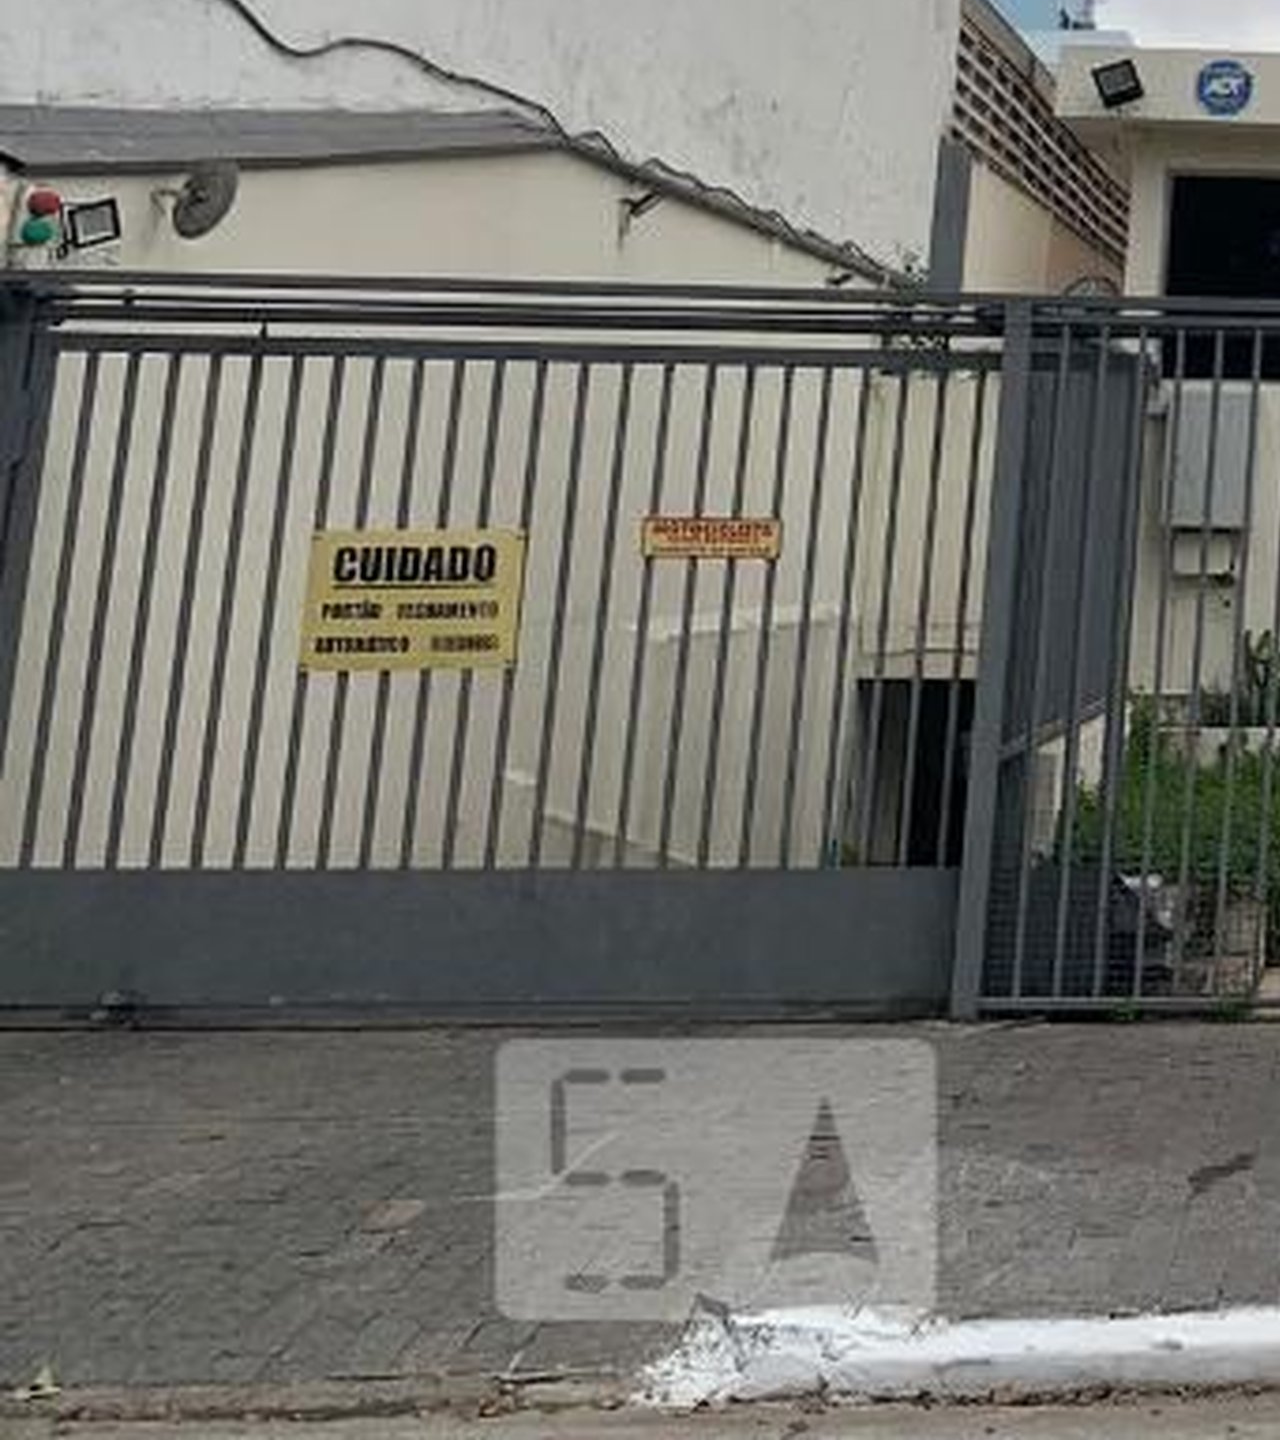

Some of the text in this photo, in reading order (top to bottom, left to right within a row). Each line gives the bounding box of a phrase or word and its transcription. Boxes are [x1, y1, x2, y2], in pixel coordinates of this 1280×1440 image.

[333, 543, 498, 582] CUIDADO
[321, 599, 500, 620] PORTÃO FECHAMENTO
